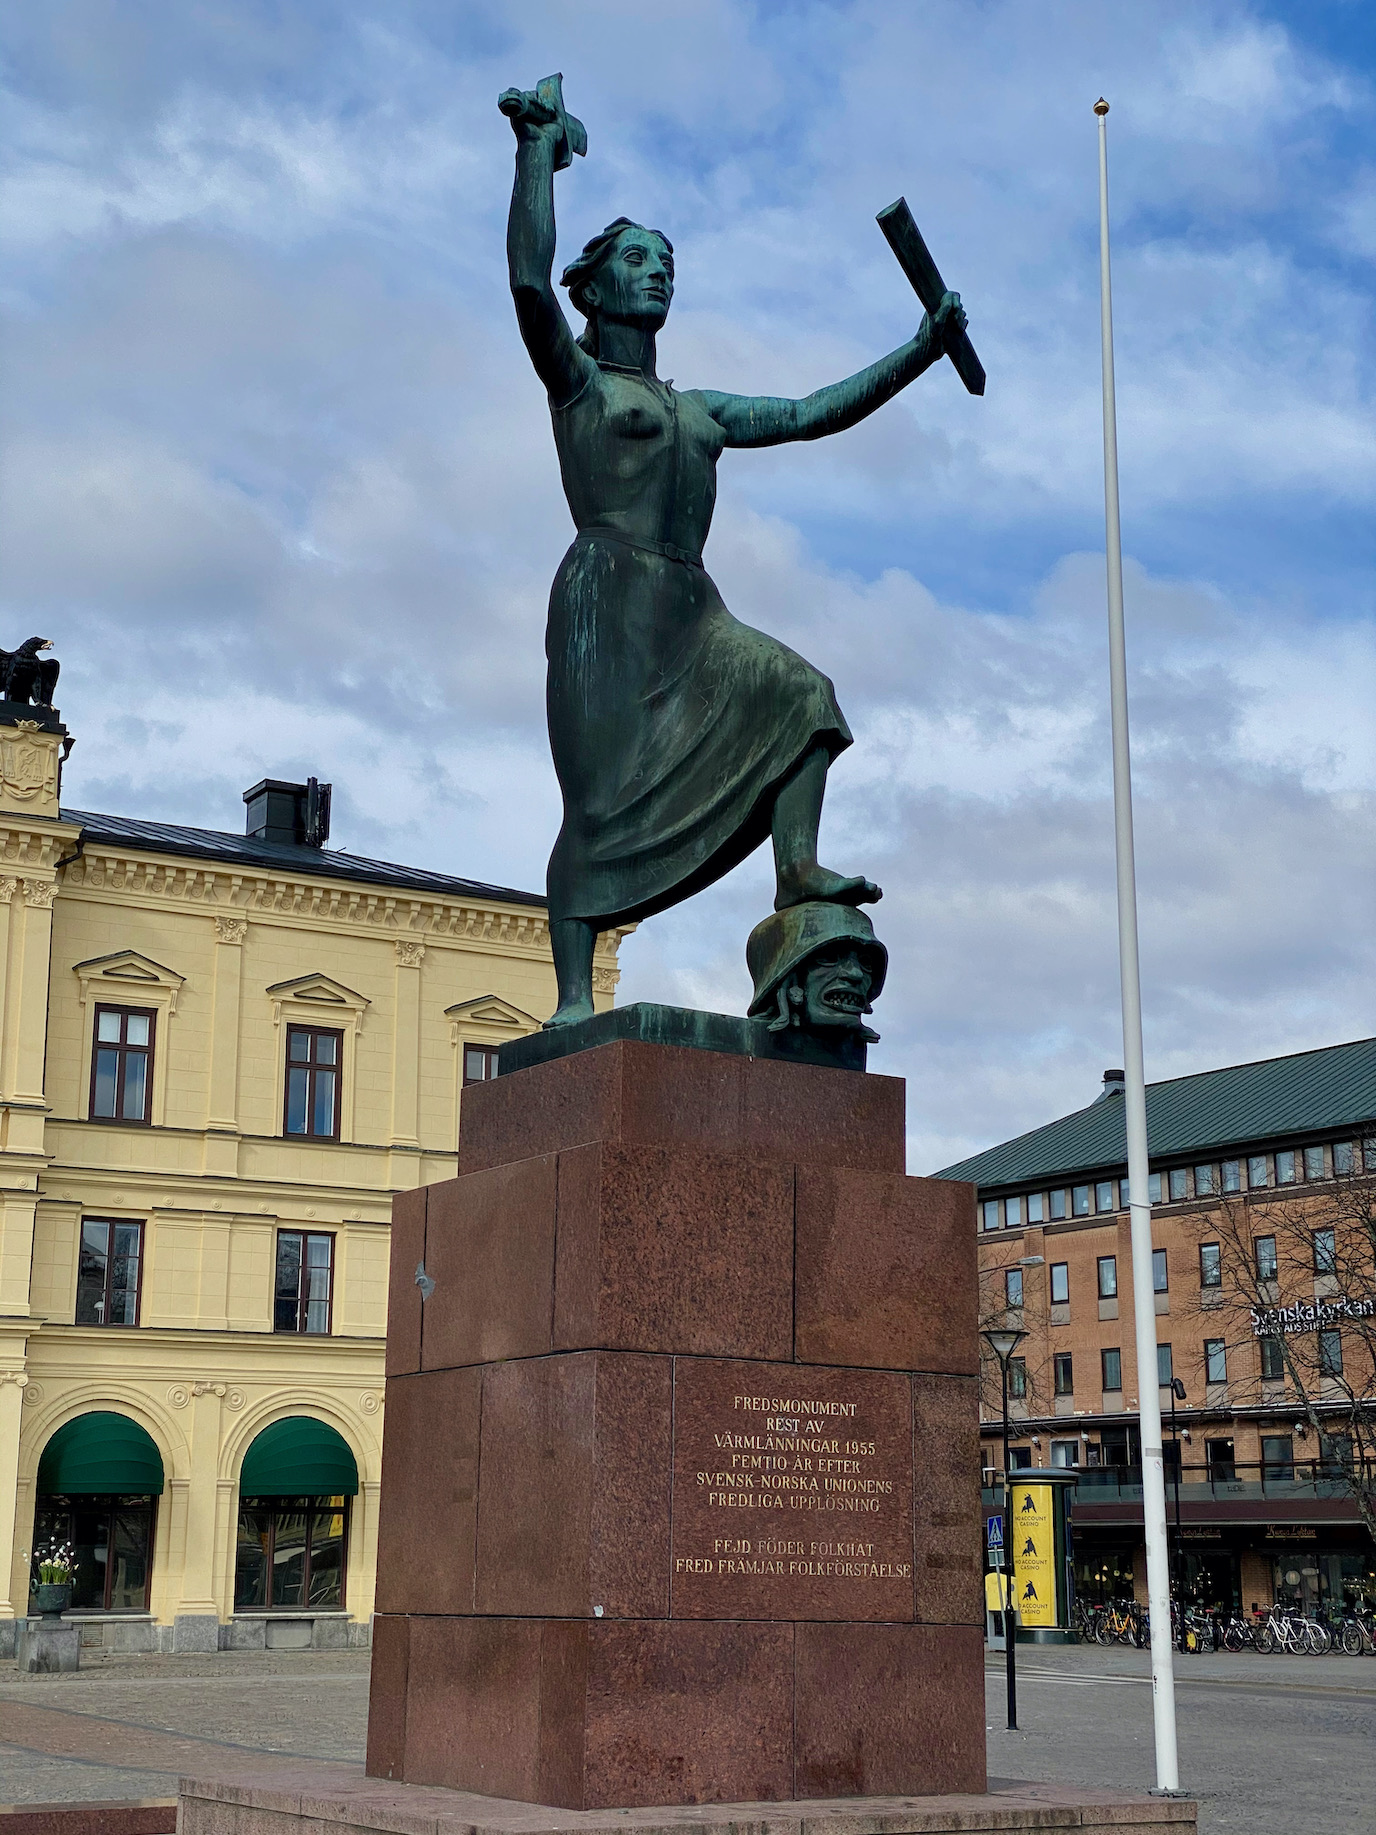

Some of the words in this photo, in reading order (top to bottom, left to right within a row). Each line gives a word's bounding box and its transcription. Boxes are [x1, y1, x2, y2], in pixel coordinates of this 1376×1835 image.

[734, 1396, 857, 1416] FREDSMONUMENT
[766, 1417, 800, 1432] REST
[805, 1420, 824, 1433] AV
[714, 1431, 840, 1454] VÄRMLÄNNINGAR
[845, 1441, 876, 1455] 1955
[732, 1454, 787, 1470] FEMTIO
[793, 1455, 813, 1471] ÅR
[818, 1459, 860, 1473] EFTER
[696, 1472, 819, 1490] SVENSK-NORSKA
[824, 1478, 893, 1494] UNIONENS
[709, 1492, 783, 1508] FREDLIGA
[790, 1494, 880, 1512] UPPLÖSNING
[714, 1539, 751, 1553] FEJD
[758, 1537, 805, 1555] FÖDER
[810, 1541, 874, 1557] FOLKHAT
[676, 1558, 713, 1573] FRED
[718, 1557, 784, 1575] FRÄMJAR
[789, 1559, 911, 1578] FOLKFÖRSTÅELSE
